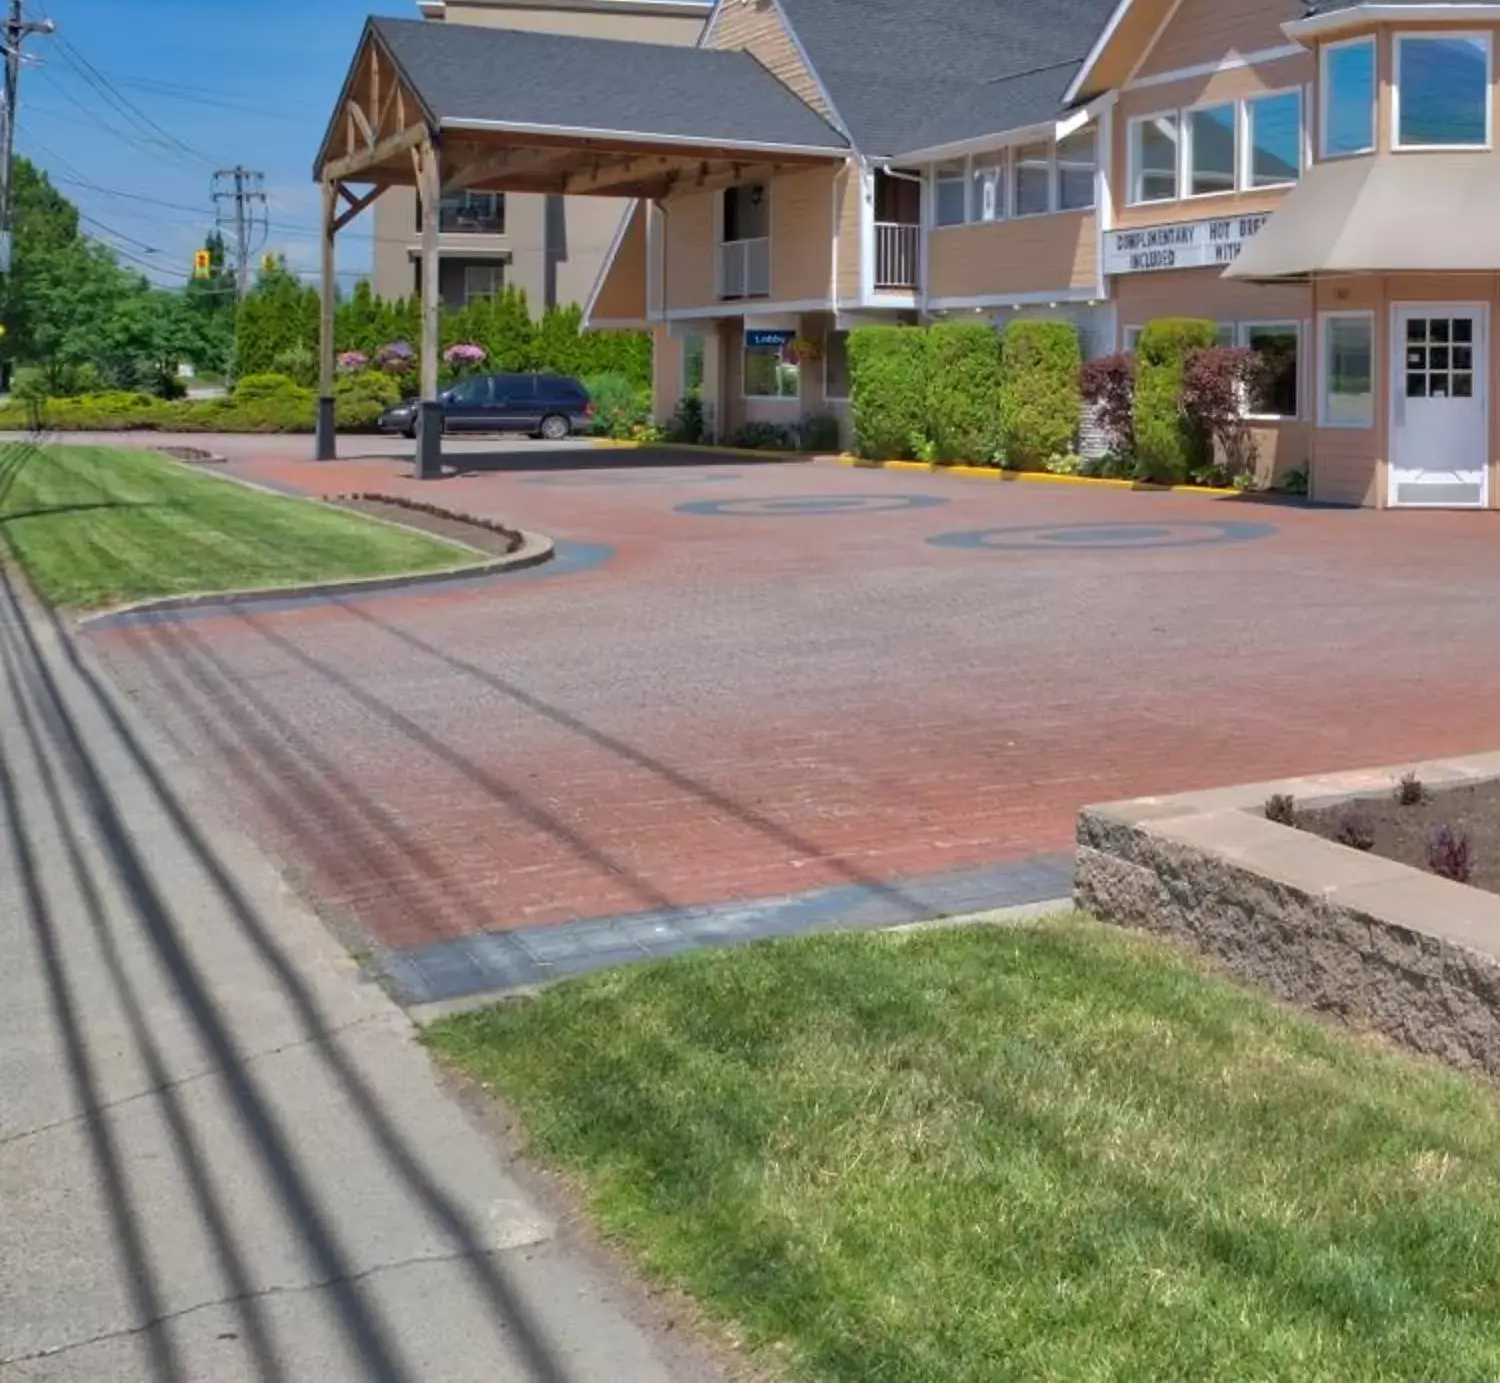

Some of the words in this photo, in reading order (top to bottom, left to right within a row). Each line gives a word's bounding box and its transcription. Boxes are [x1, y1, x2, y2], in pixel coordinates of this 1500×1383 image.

[1117, 225, 1194, 250] COMPLIMENTARY
[1209, 221, 1230, 240] HOT
[1129, 249, 1175, 268] INCLUDED
